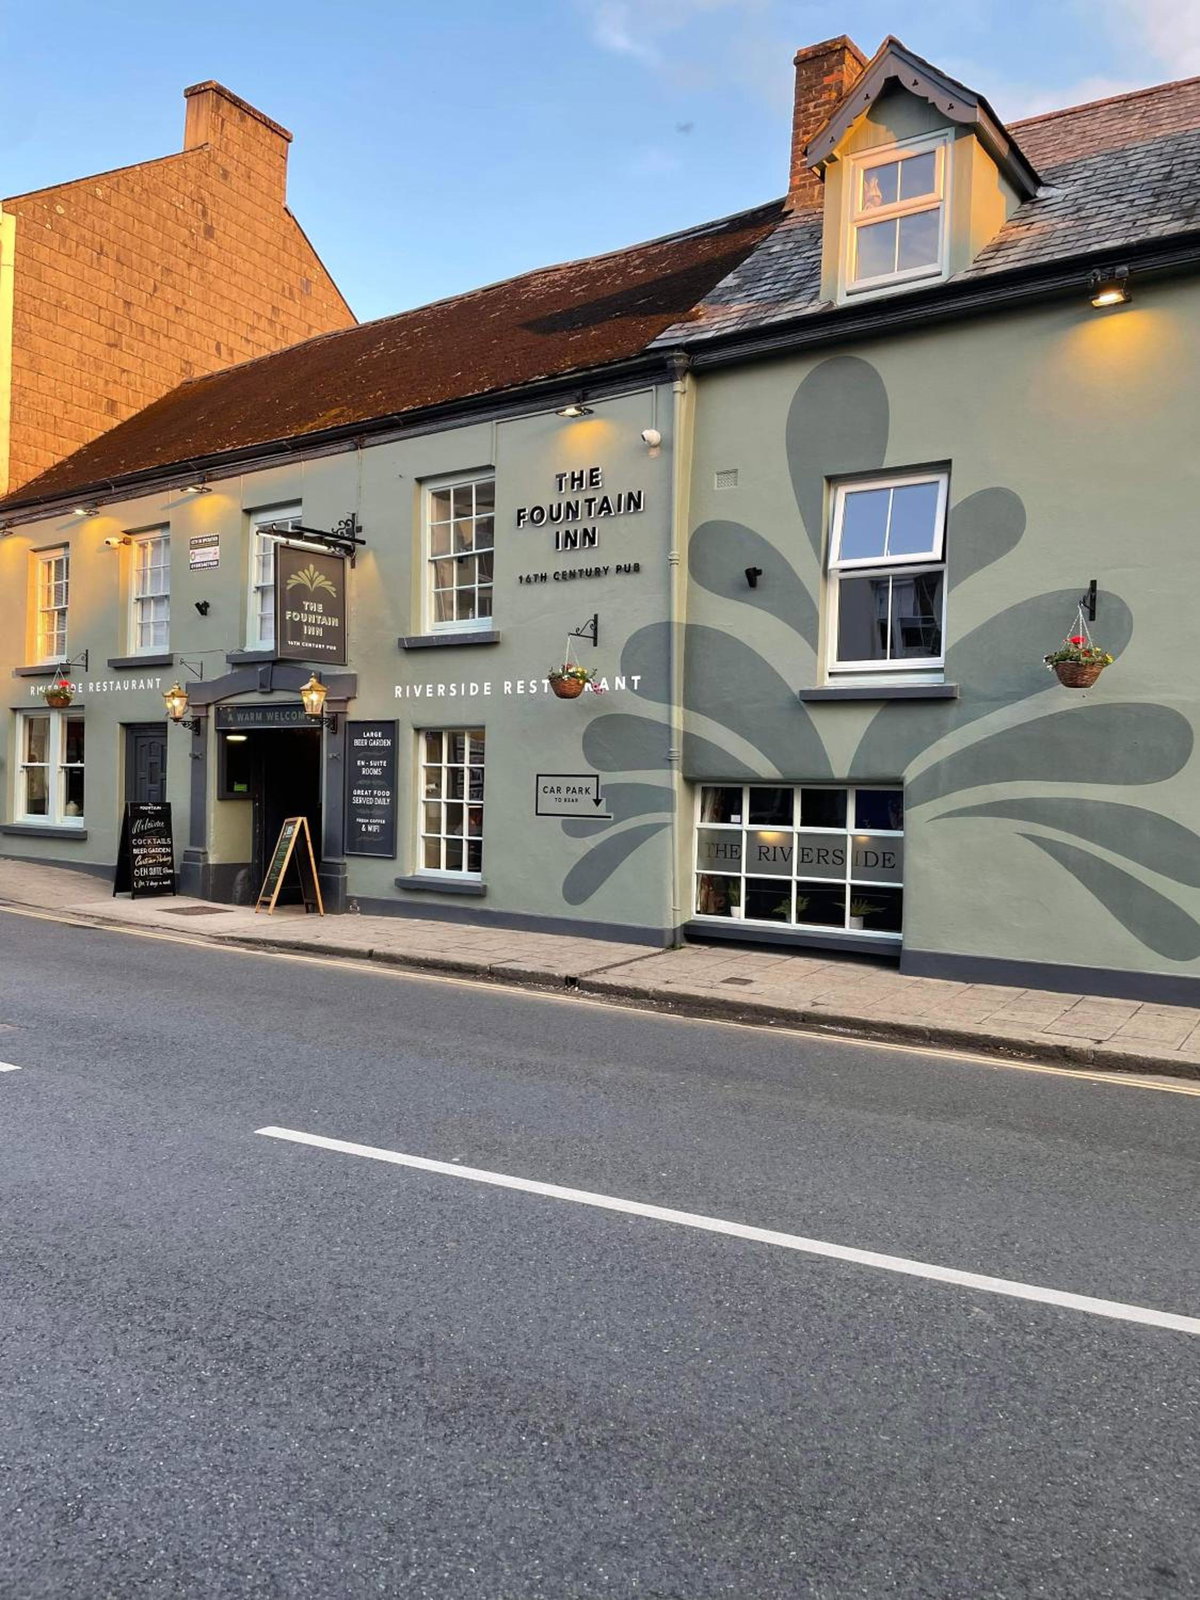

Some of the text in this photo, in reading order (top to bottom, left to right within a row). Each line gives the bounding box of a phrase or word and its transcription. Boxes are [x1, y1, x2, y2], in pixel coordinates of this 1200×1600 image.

[555, 466, 602, 493] THE
[516, 490, 644, 529] FOUNTAIN
[555, 526, 599, 552] INN
[518, 562, 640, 584] 16TH CENTURY PUB
[303, 601, 323, 612] THE
[285, 611, 339, 627] FOUNTAIN
[303, 625, 323, 637] INN
[30, 678, 161, 696] RIVIDE RESTAURANT
[394, 675, 641, 698] RIVERSIDE RESTRANT
[227, 713, 233, 722] A
[236, 711, 262, 721] WARM
[353, 739, 392, 747] BEER GARDEN
[361, 767, 383, 776] ROOMS
[542, 785, 591, 795] CAR PARK
[352, 796, 391, 805] SERVED DAILY
[361, 824, 367, 832] &
[706, 843, 896, 869] THE RIVERSIDE
[140, 867, 149, 877] EN
